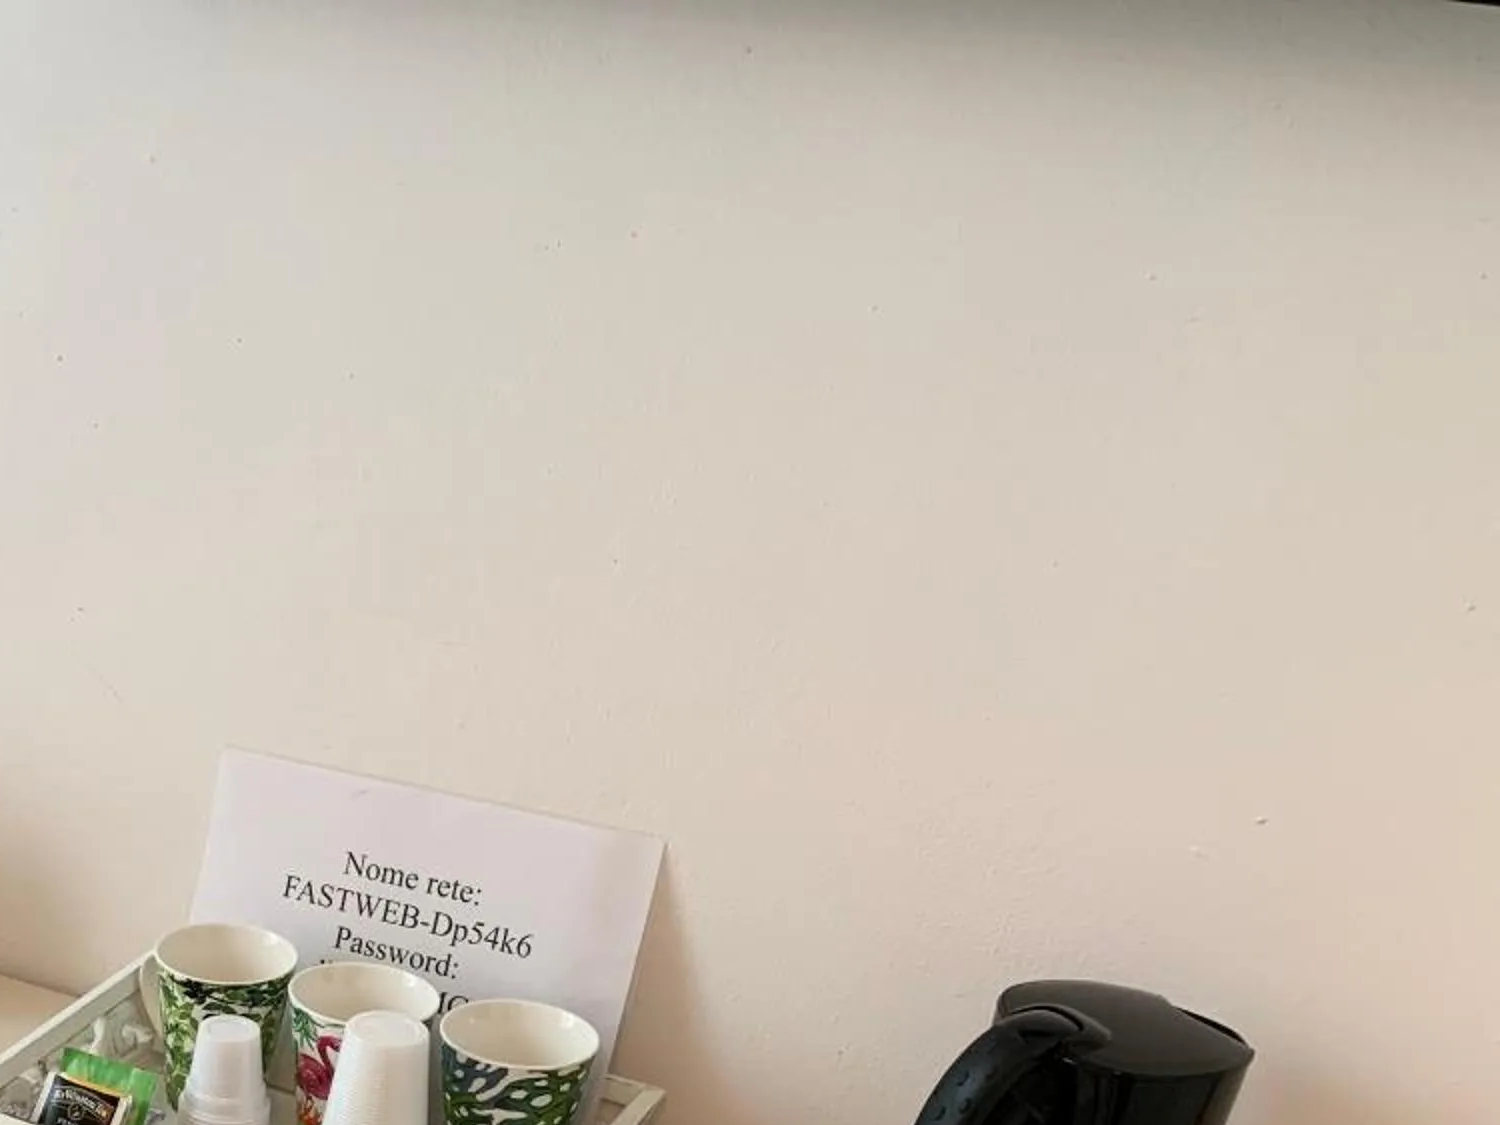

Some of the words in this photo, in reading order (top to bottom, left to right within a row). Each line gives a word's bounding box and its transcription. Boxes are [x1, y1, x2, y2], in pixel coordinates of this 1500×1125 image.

[344, 851, 420, 890] Nome
[426, 877, 483, 907] rete:
[283, 874, 533, 959] FASTWEB-Dp54k6
[334, 926, 460, 979] Password:
